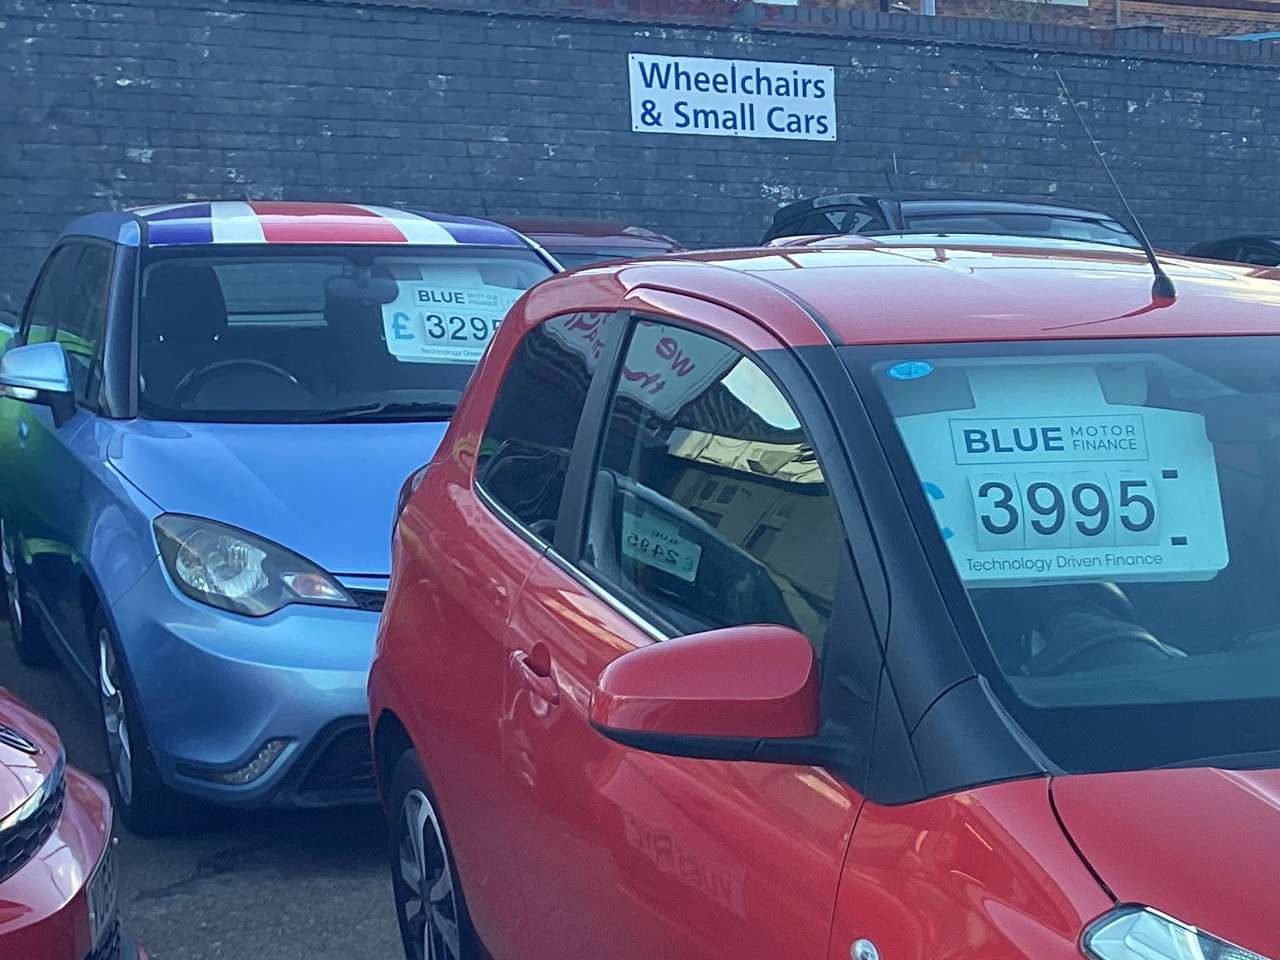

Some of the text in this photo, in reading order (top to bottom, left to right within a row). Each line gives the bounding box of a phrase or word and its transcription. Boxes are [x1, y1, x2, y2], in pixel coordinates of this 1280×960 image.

[639, 61, 825, 99] Wheelchairs
[641, 99, 828, 134] & Small Cars
[418, 290, 465, 304] BLUE
[964, 427, 1065, 454] BLUE
[1070, 425, 1136, 437] MOTOR
[1072, 437, 1138, 451] FINANCE
[978, 479, 1155, 537] 3995
[967, 553, 1163, 573] Technology Driven Finance
